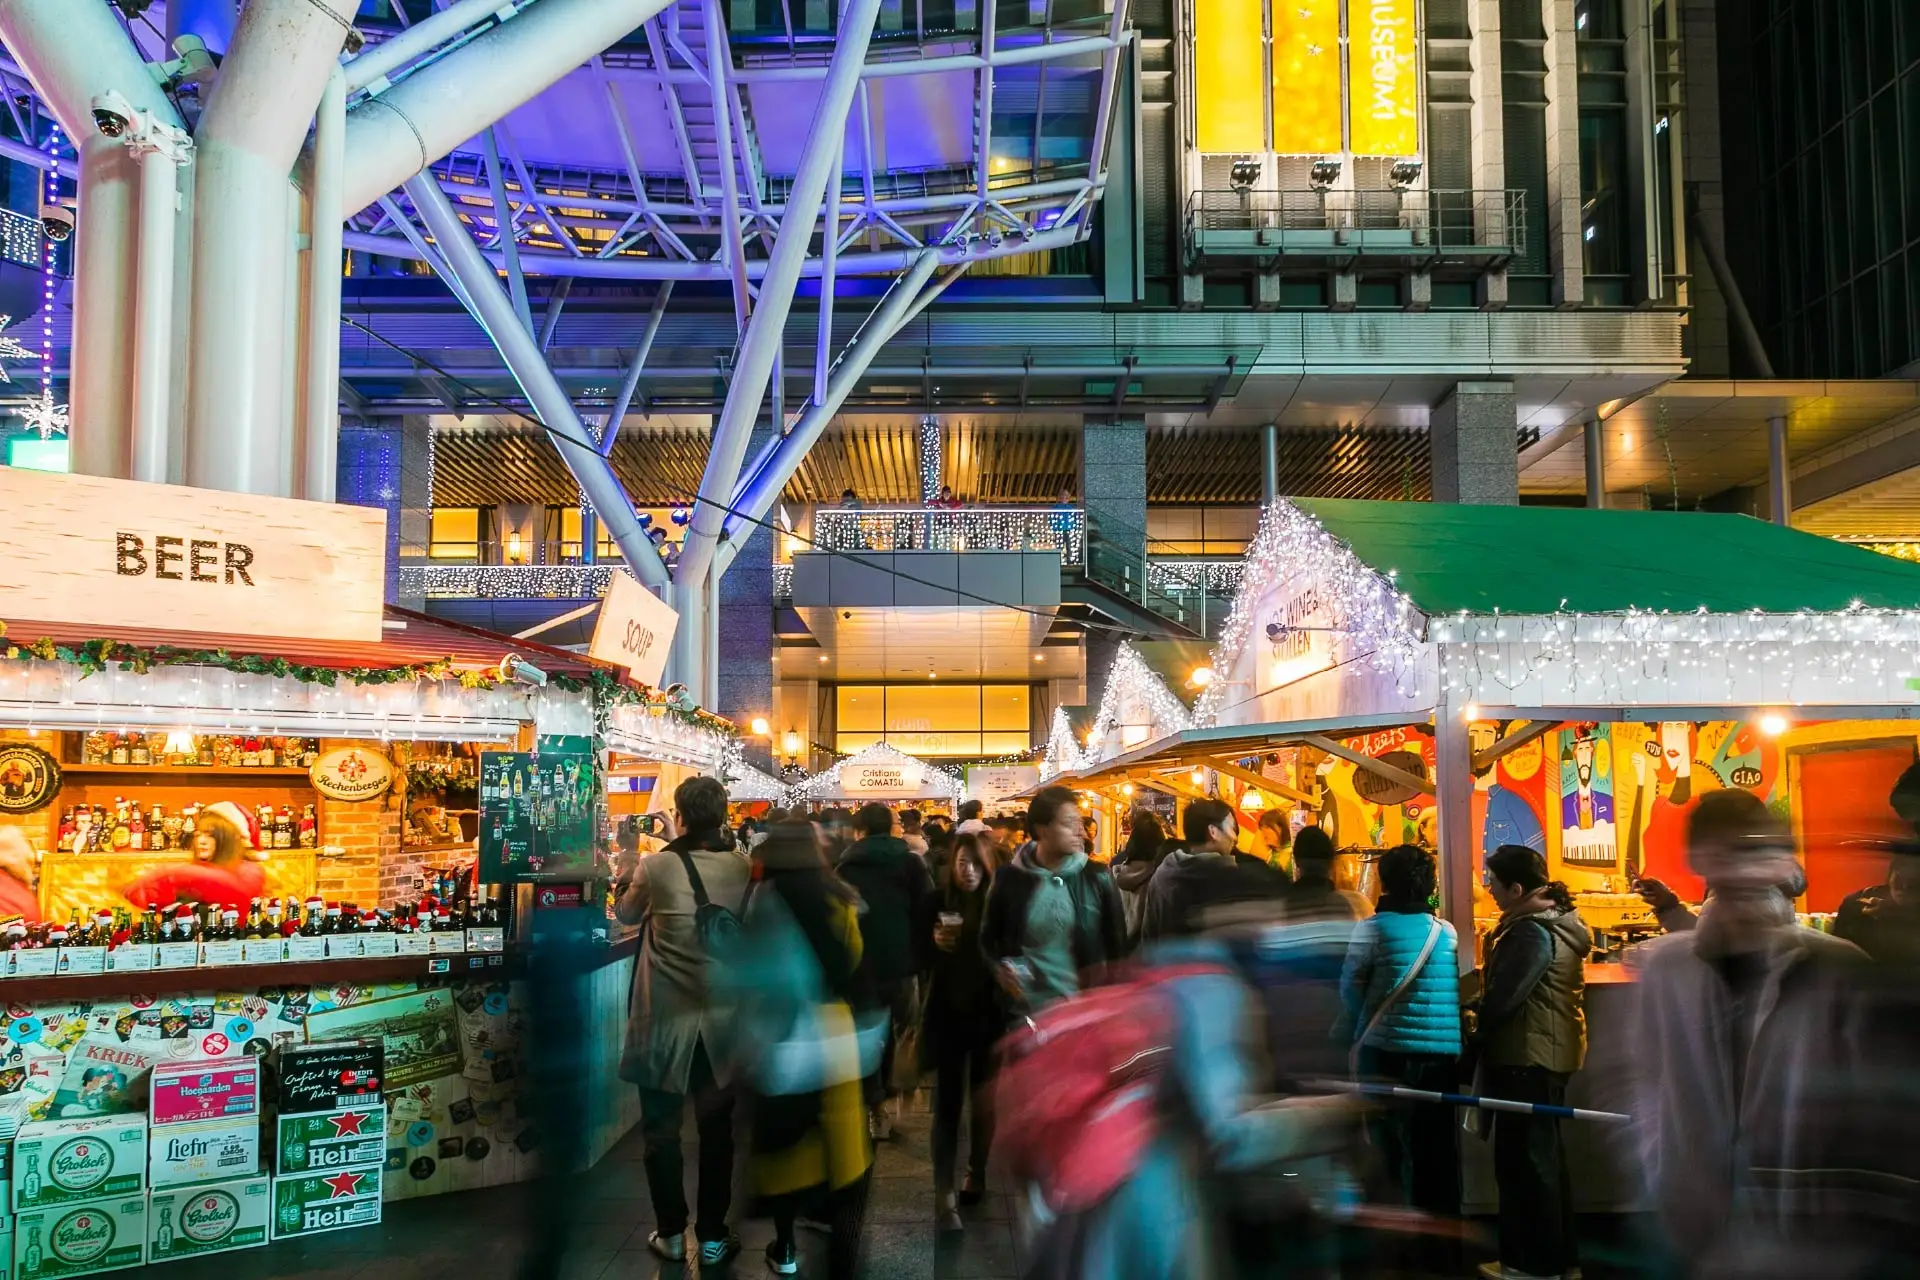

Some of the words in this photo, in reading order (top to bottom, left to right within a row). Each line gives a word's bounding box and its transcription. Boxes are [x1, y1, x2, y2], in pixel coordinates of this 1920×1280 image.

[1370, 0, 1396, 119] USEUM
[116, 531, 255, 587] BEER
[622, 618, 654, 660] SOUP
[1646, 742, 1662, 757] FUN
[859, 778, 904, 787] COMATSU
[862, 769, 901, 778] Cristiano
[1733, 771, 1761, 785] CIAO
[85, 1045, 151, 1069] KRIEK
[180, 1083, 231, 1097] Hoegaarden
[56, 1153, 107, 1175] Grolsch
[187, 1206, 234, 1228] Grolsch
[57, 1223, 108, 1248] Grolsch
